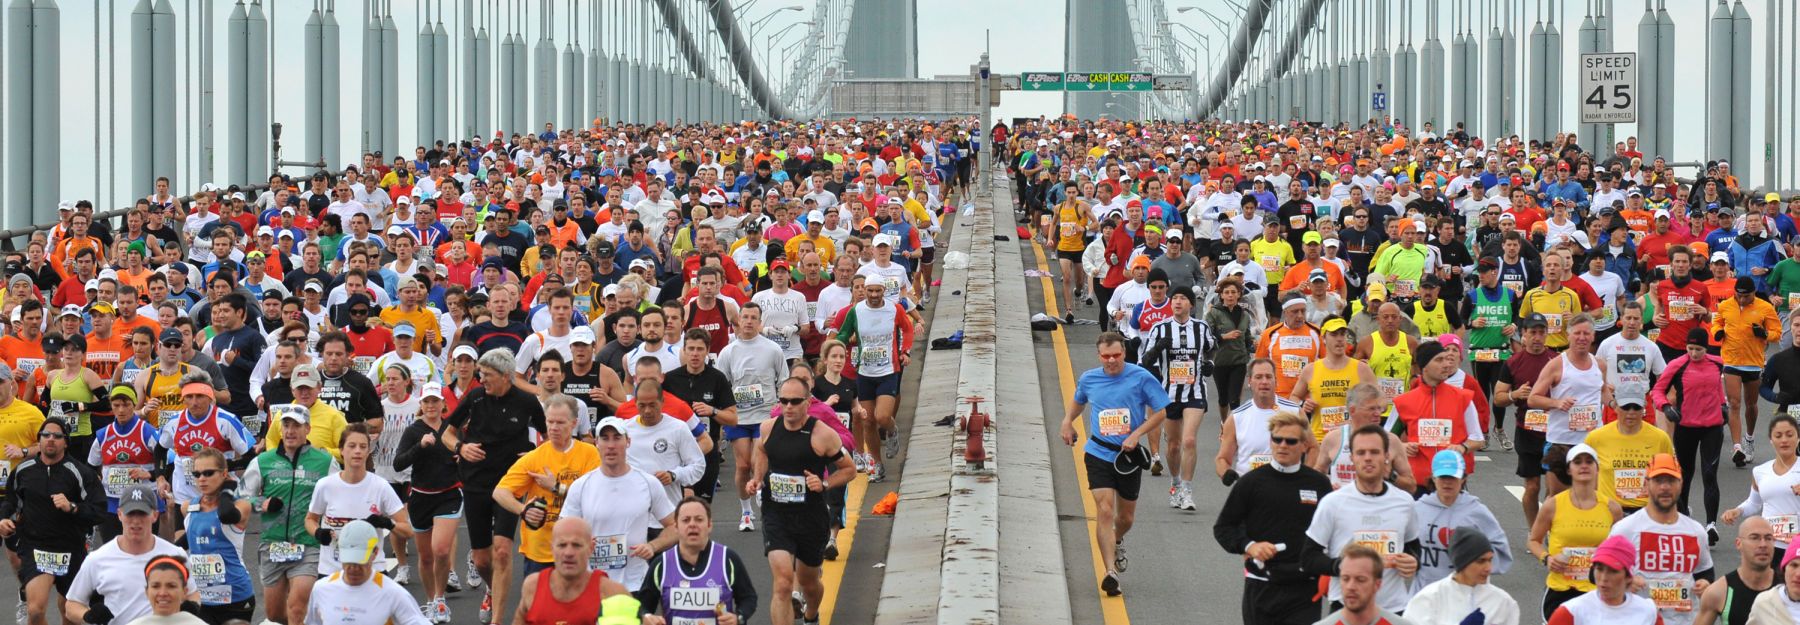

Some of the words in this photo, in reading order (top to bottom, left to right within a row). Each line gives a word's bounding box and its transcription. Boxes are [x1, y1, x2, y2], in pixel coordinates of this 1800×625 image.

[1586, 57, 1631, 68] SPEED
[1089, 74, 1108, 83] CASH
[1110, 74, 1128, 83] CASH
[1591, 71, 1625, 81] LIMIT
[1586, 84, 1631, 109] 45
[1477, 305, 1509, 315] NIGEL
[1189, 367, 1194, 375] E
[1320, 379, 1350, 387] JONESY
[755, 389, 761, 399] B
[1100, 416, 1121, 426] 31661
[1123, 415, 1129, 424] C
[1419, 426, 1441, 436] 15078
[1443, 427, 1449, 436] F
[178, 429, 216, 447] ITALIA
[105, 438, 142, 457] ITALIA
[1612, 459, 1621, 468] GO
[1623, 459, 1636, 468] NEIL
[2, 467, 9, 478] A
[1620, 469, 1636, 477] ING
[771, 482, 794, 493] 25435
[796, 484, 803, 493] D
[1617, 477, 1641, 488] 29708
[1788, 522, 1795, 533] F
[1361, 533, 1379, 541] ING
[1425, 523, 1438, 545] I
[195, 536, 210, 545] USA
[1658, 535, 1684, 553] GO
[617, 543, 624, 555] B
[1388, 541, 1396, 553] G
[61, 554, 68, 565] C
[1568, 555, 1592, 566] 2209
[1644, 552, 1698, 571] BEAT
[191, 562, 212, 575] 4537
[215, 562, 222, 574] C
[1656, 580, 1674, 588] ING
[673, 591, 715, 607] PAUL
[1651, 588, 1679, 601] 30361
[1681, 588, 1688, 600] B
